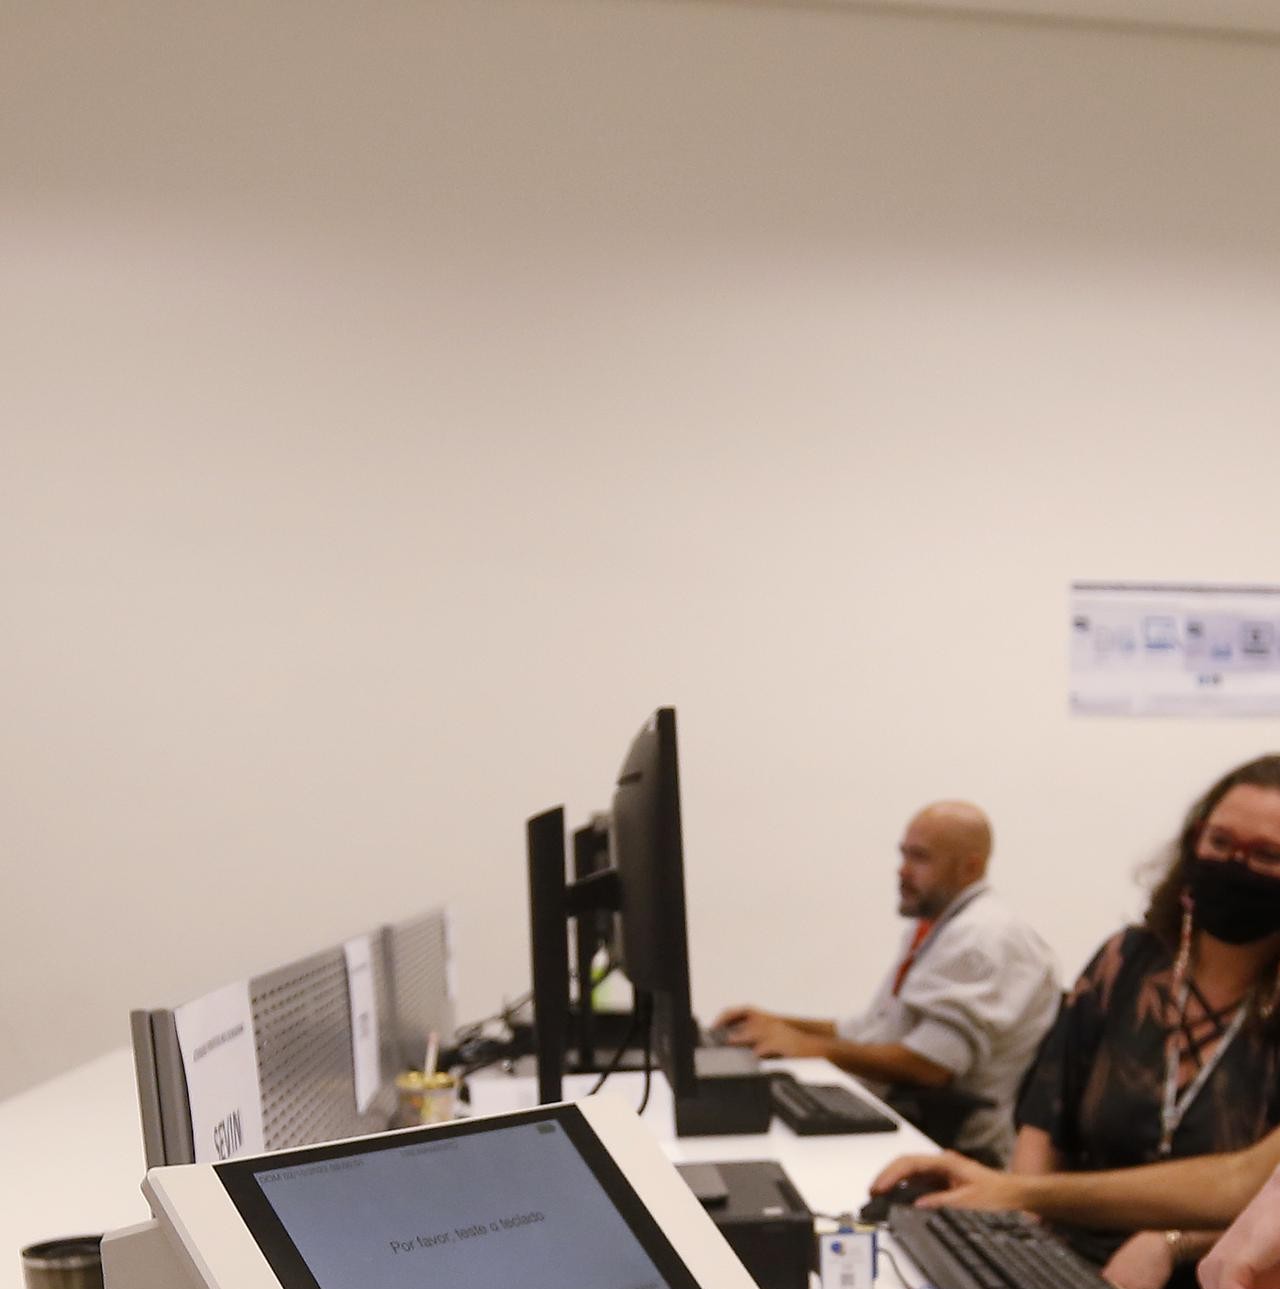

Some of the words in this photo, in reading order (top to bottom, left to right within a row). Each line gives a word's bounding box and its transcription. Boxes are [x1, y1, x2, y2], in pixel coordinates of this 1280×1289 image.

[389, 1237, 415, 1254] Por
[455, 1222, 488, 1241] teste
[490, 1222, 499, 1233] o
[500, 1209, 545, 1231] teclado
